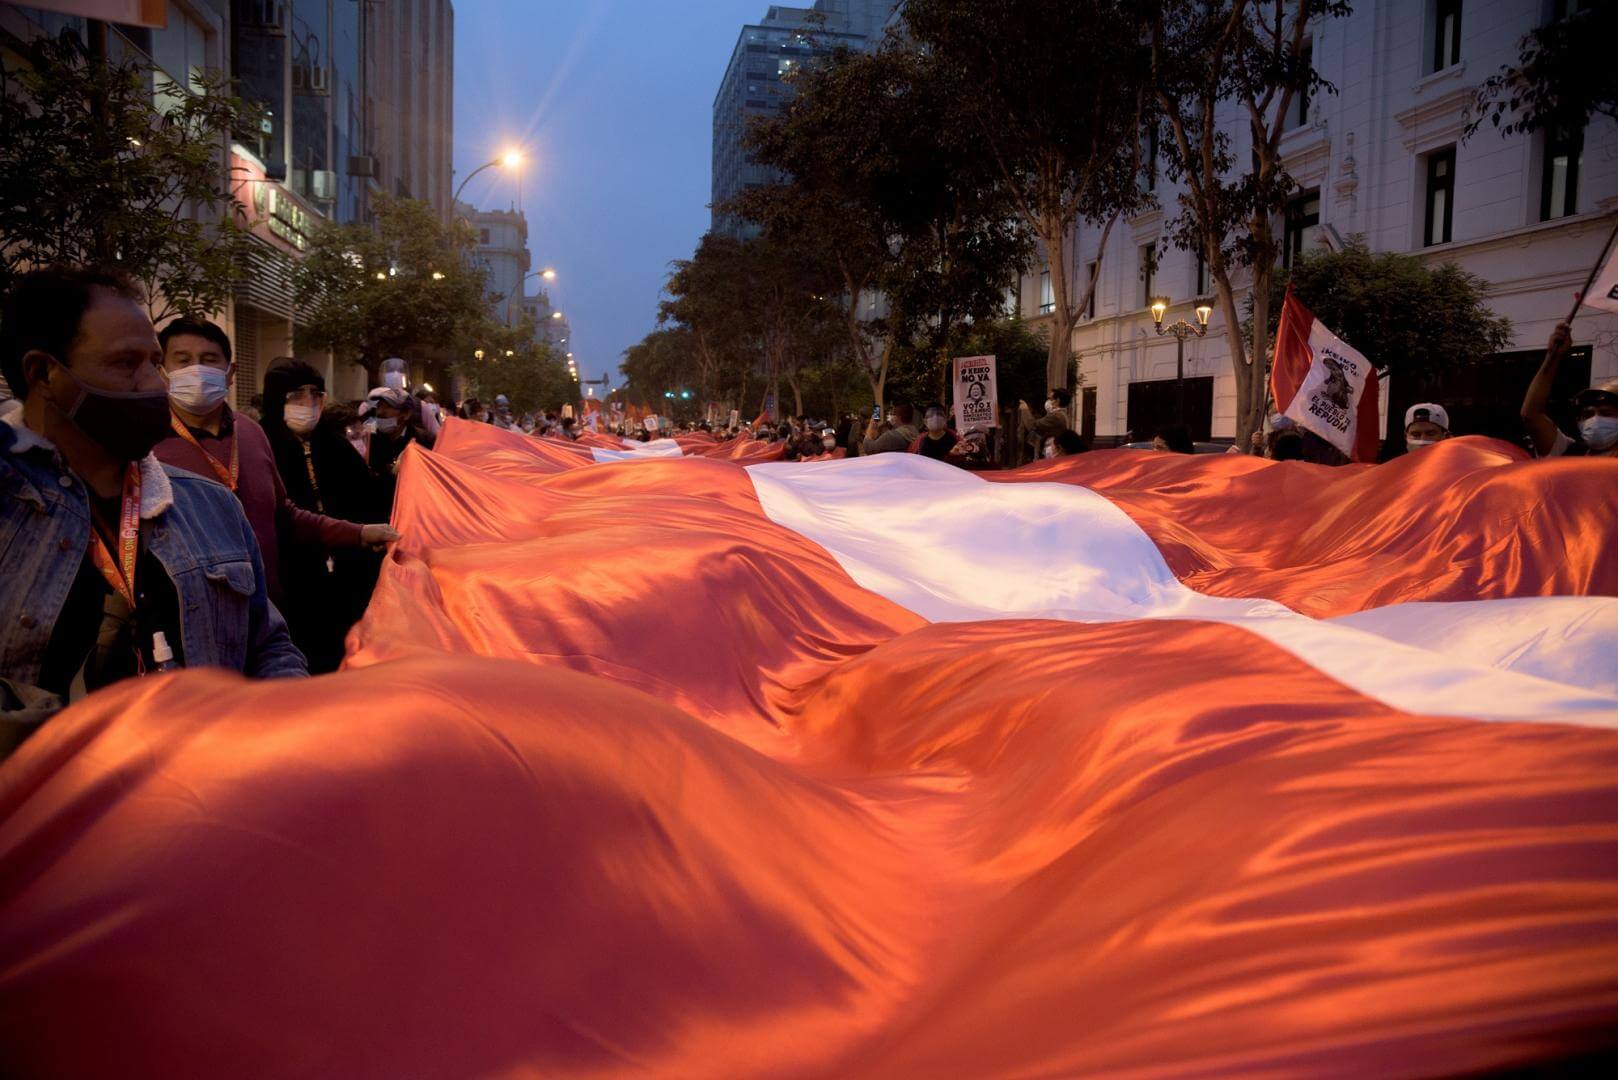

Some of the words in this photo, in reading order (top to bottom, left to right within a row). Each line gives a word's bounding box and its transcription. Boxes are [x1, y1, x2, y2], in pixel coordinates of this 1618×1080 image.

[962, 375, 975, 383] NO
[1312, 395, 1320, 404] EL
[1320, 401, 1345, 420] PUEBLO
[1308, 403, 1348, 433] REPUDIA
[124, 539, 133, 551] NO
